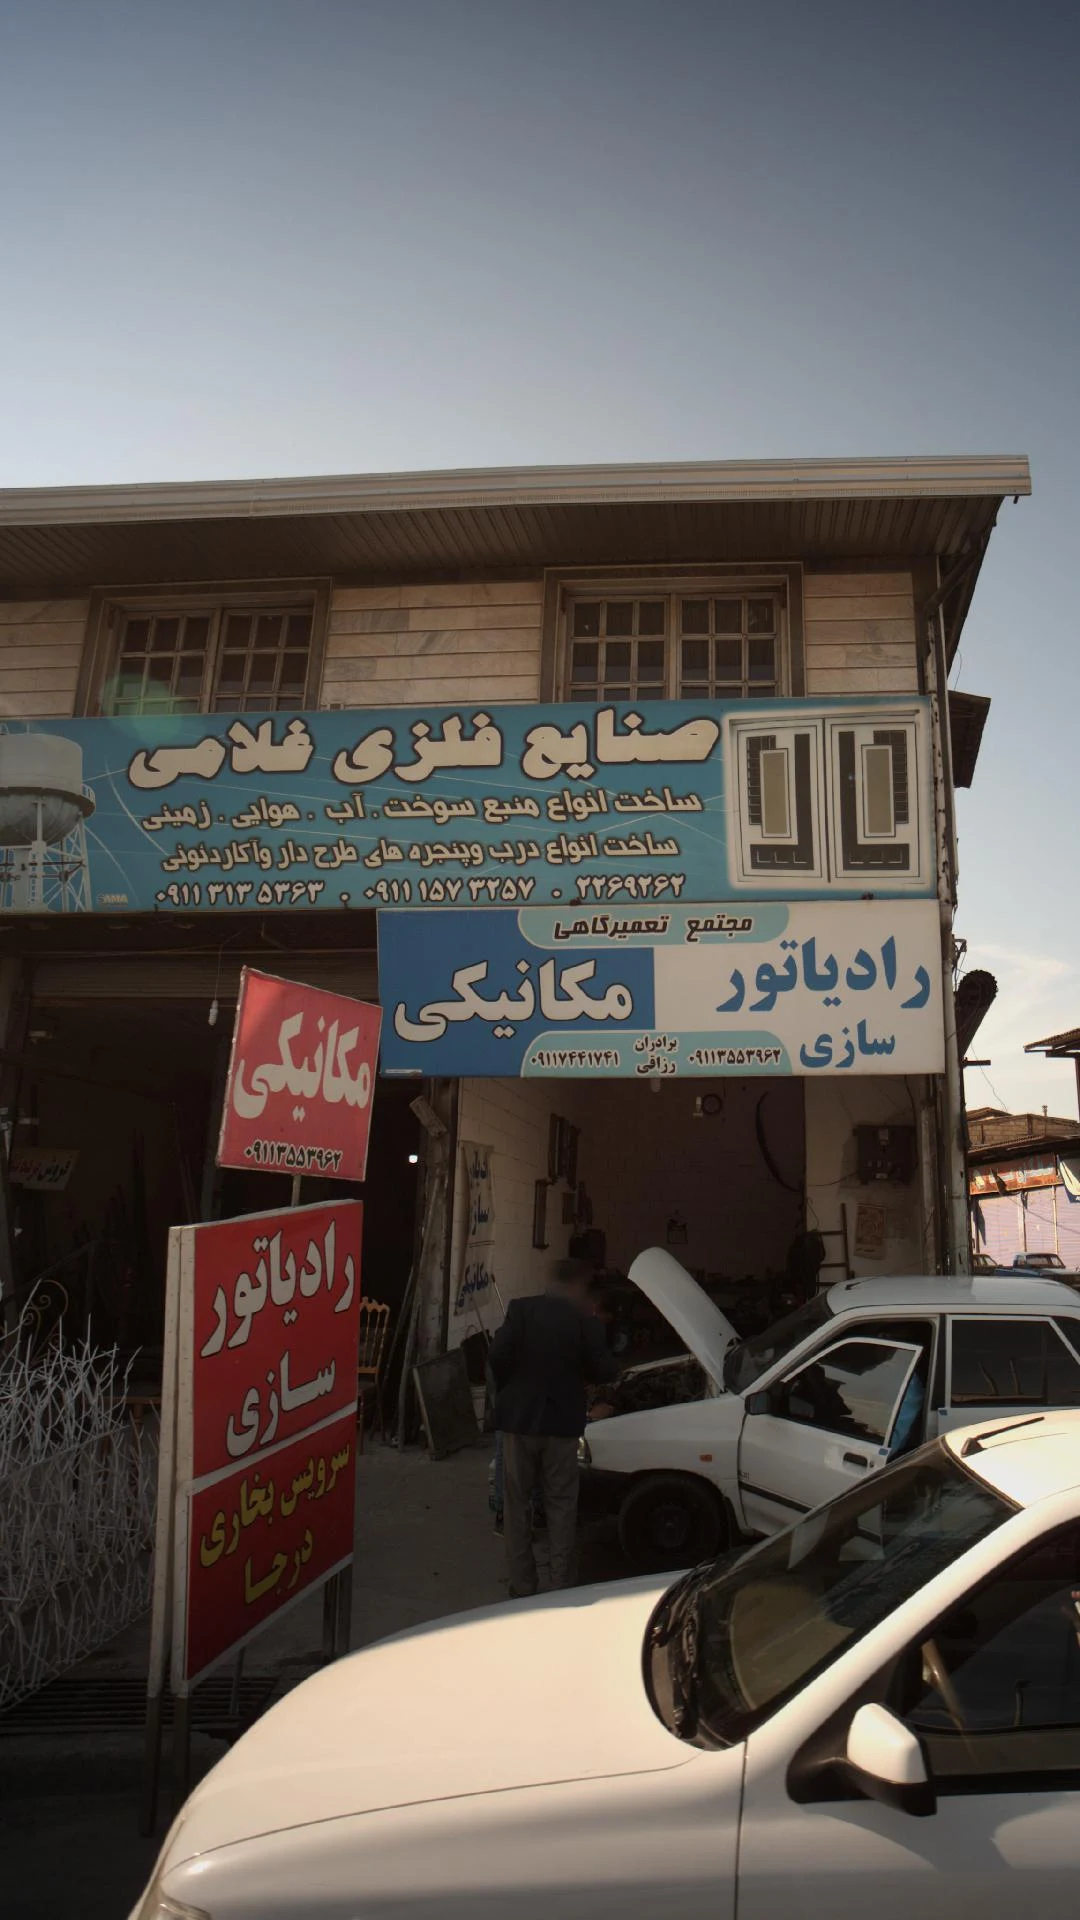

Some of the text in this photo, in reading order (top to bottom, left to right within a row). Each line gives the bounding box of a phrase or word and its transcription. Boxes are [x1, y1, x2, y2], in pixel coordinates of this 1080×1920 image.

[128, 708, 719, 789] صنایع فلزی غلامی
[142, 787, 703, 830] ساخت انواع منبع سوخت آب هوایی زمینی
[277, 841, 309, 870] دار
[313, 839, 358, 869] طرح
[363, 839, 405, 868] های
[489, 841, 541, 866] درب
[546, 834, 599, 864] انواع
[602, 832, 680, 857] ساخت
[553, 912, 753, 942] مجتمع تعمیرگاهی
[715, 934, 931, 1013] رادیاتور
[393, 957, 634, 1043] مکانیکی
[530, 1050, 620, 1067] ۰۹۱۱۷۴۴۱۷۴۱
[635, 1035, 678, 1052] برادران
[799, 1019, 896, 1069] سازی
[232, 1011, 372, 1122] مکانیکی
[636, 1055, 678, 1074] رزاقی
[200, 1219, 356, 1358] رادیاتور
[225, 1350, 337, 1459] سازی
[200, 1441, 350, 1568] سرویس بخاری
